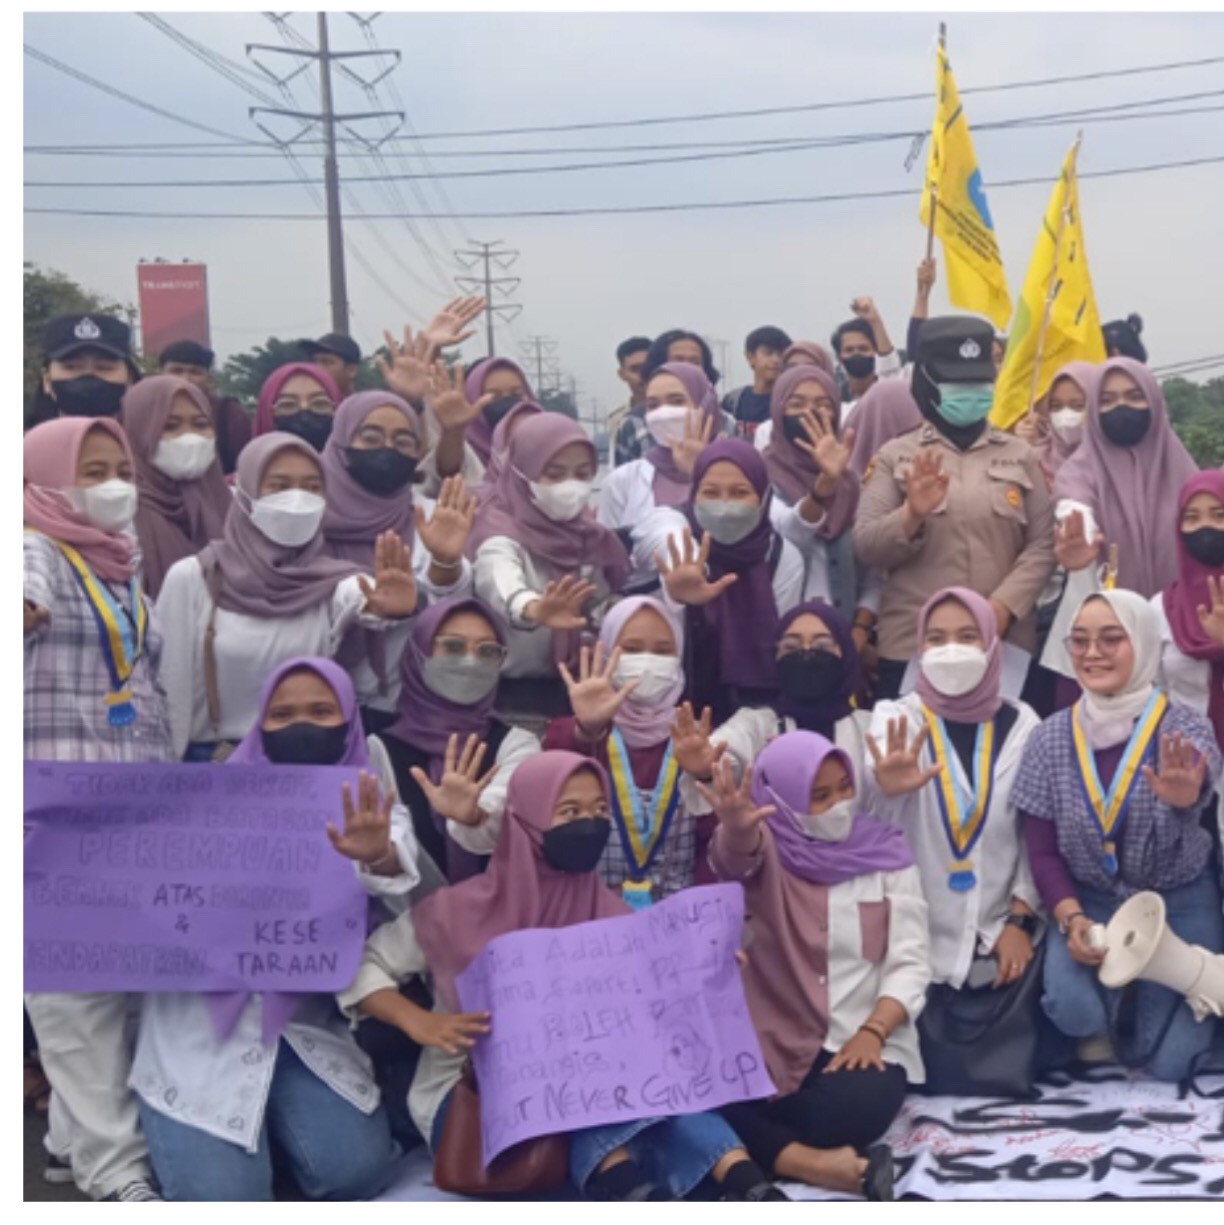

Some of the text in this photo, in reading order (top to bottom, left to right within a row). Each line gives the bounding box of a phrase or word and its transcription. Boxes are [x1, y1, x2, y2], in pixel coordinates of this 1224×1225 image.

[79, 830, 325, 873] PEREMPUAN
[153, 883, 206, 908] ATAS
[254, 918, 321, 945] KESE
[236, 950, 339, 977] TARAAN
[544, 1079, 636, 1122] NEVER
[640, 1073, 714, 1111] GIVE
